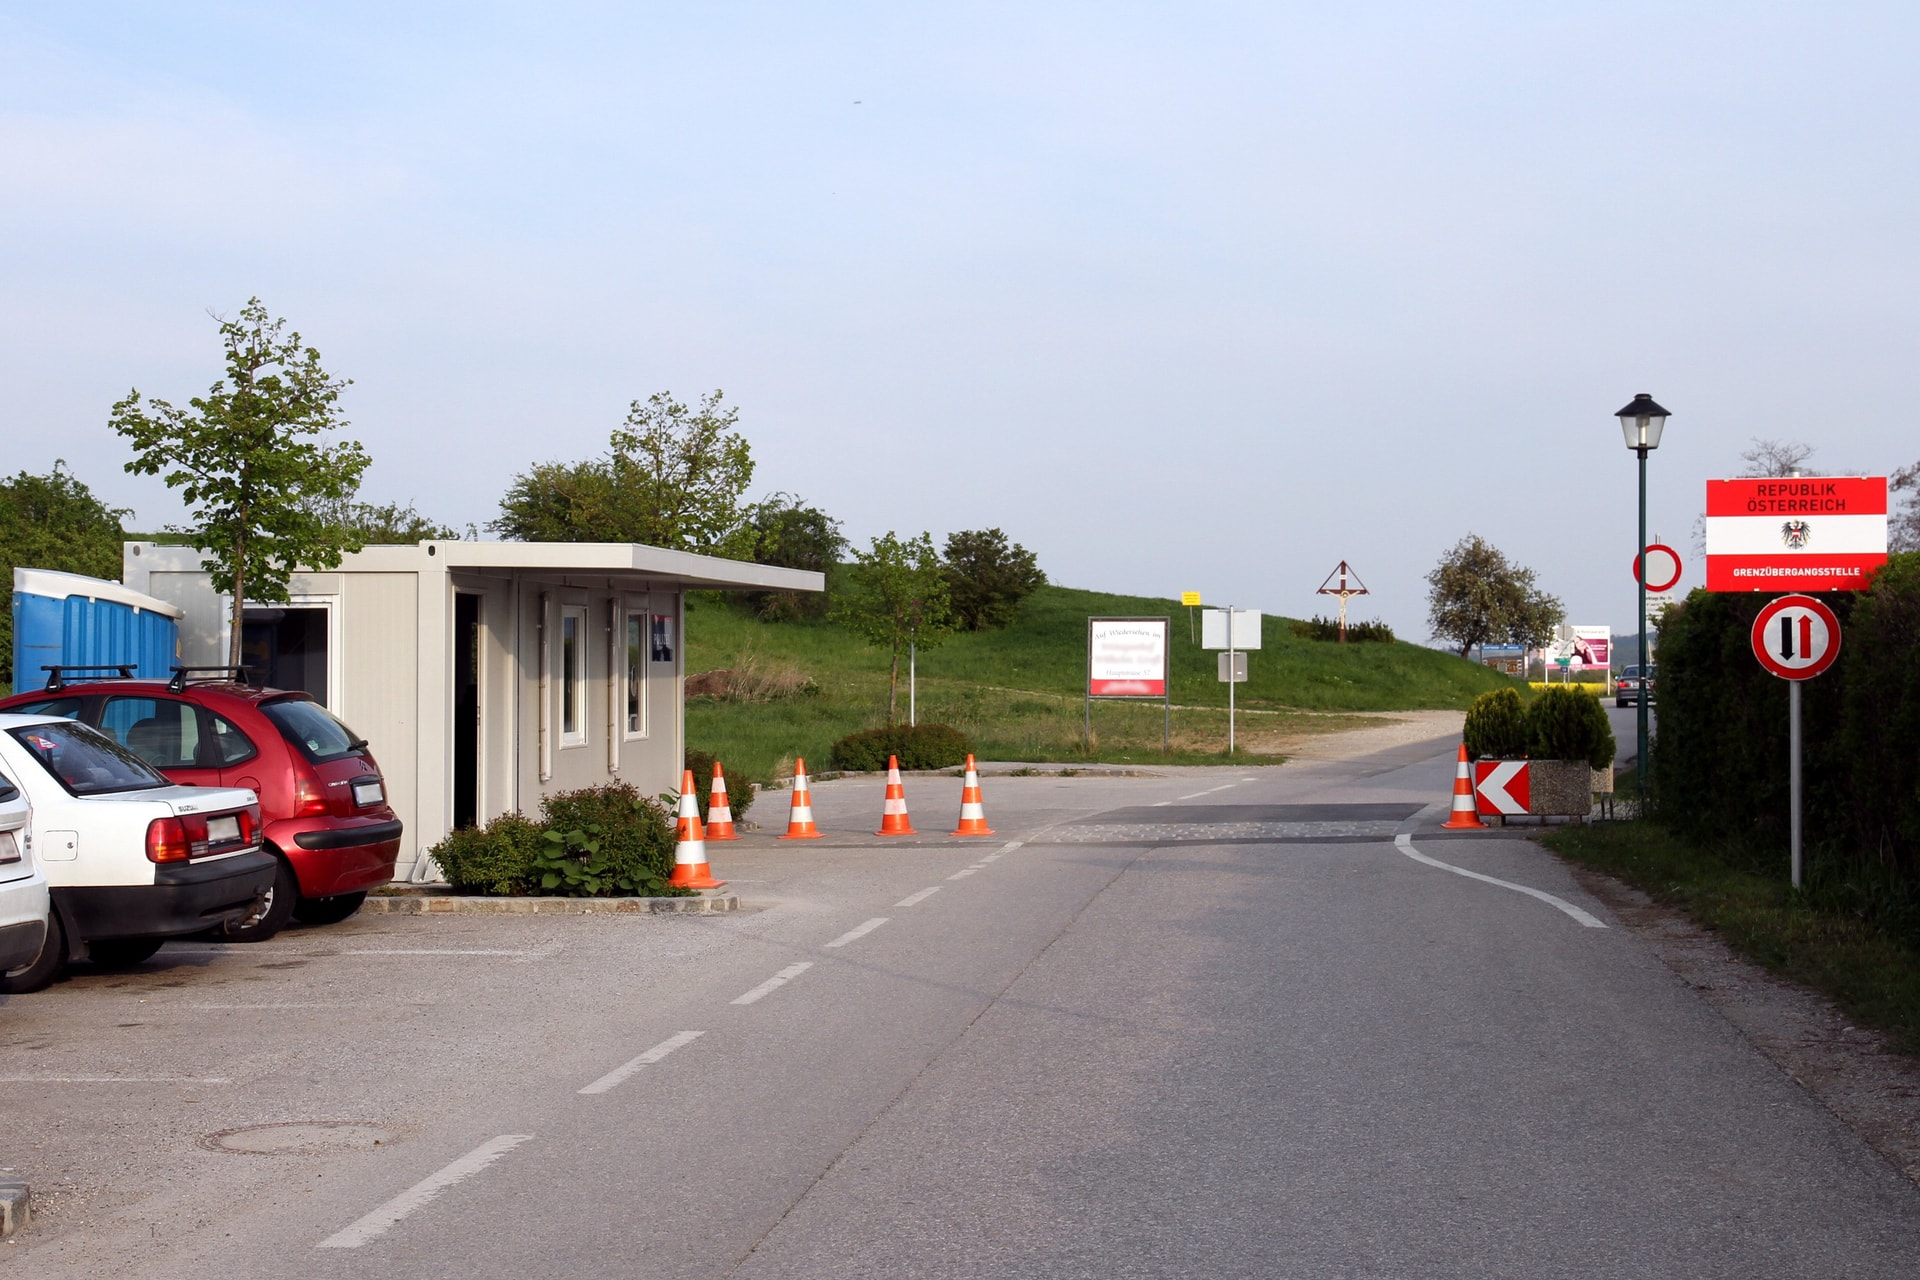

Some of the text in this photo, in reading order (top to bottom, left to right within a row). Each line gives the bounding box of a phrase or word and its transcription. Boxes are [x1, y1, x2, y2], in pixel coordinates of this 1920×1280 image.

[1757, 484, 1836, 496] REPUBLIK
[1747, 498, 1846, 512] ÖSTERREICH
[1733, 566, 1860, 577] GRENZÜBERGANGSSTELLE
